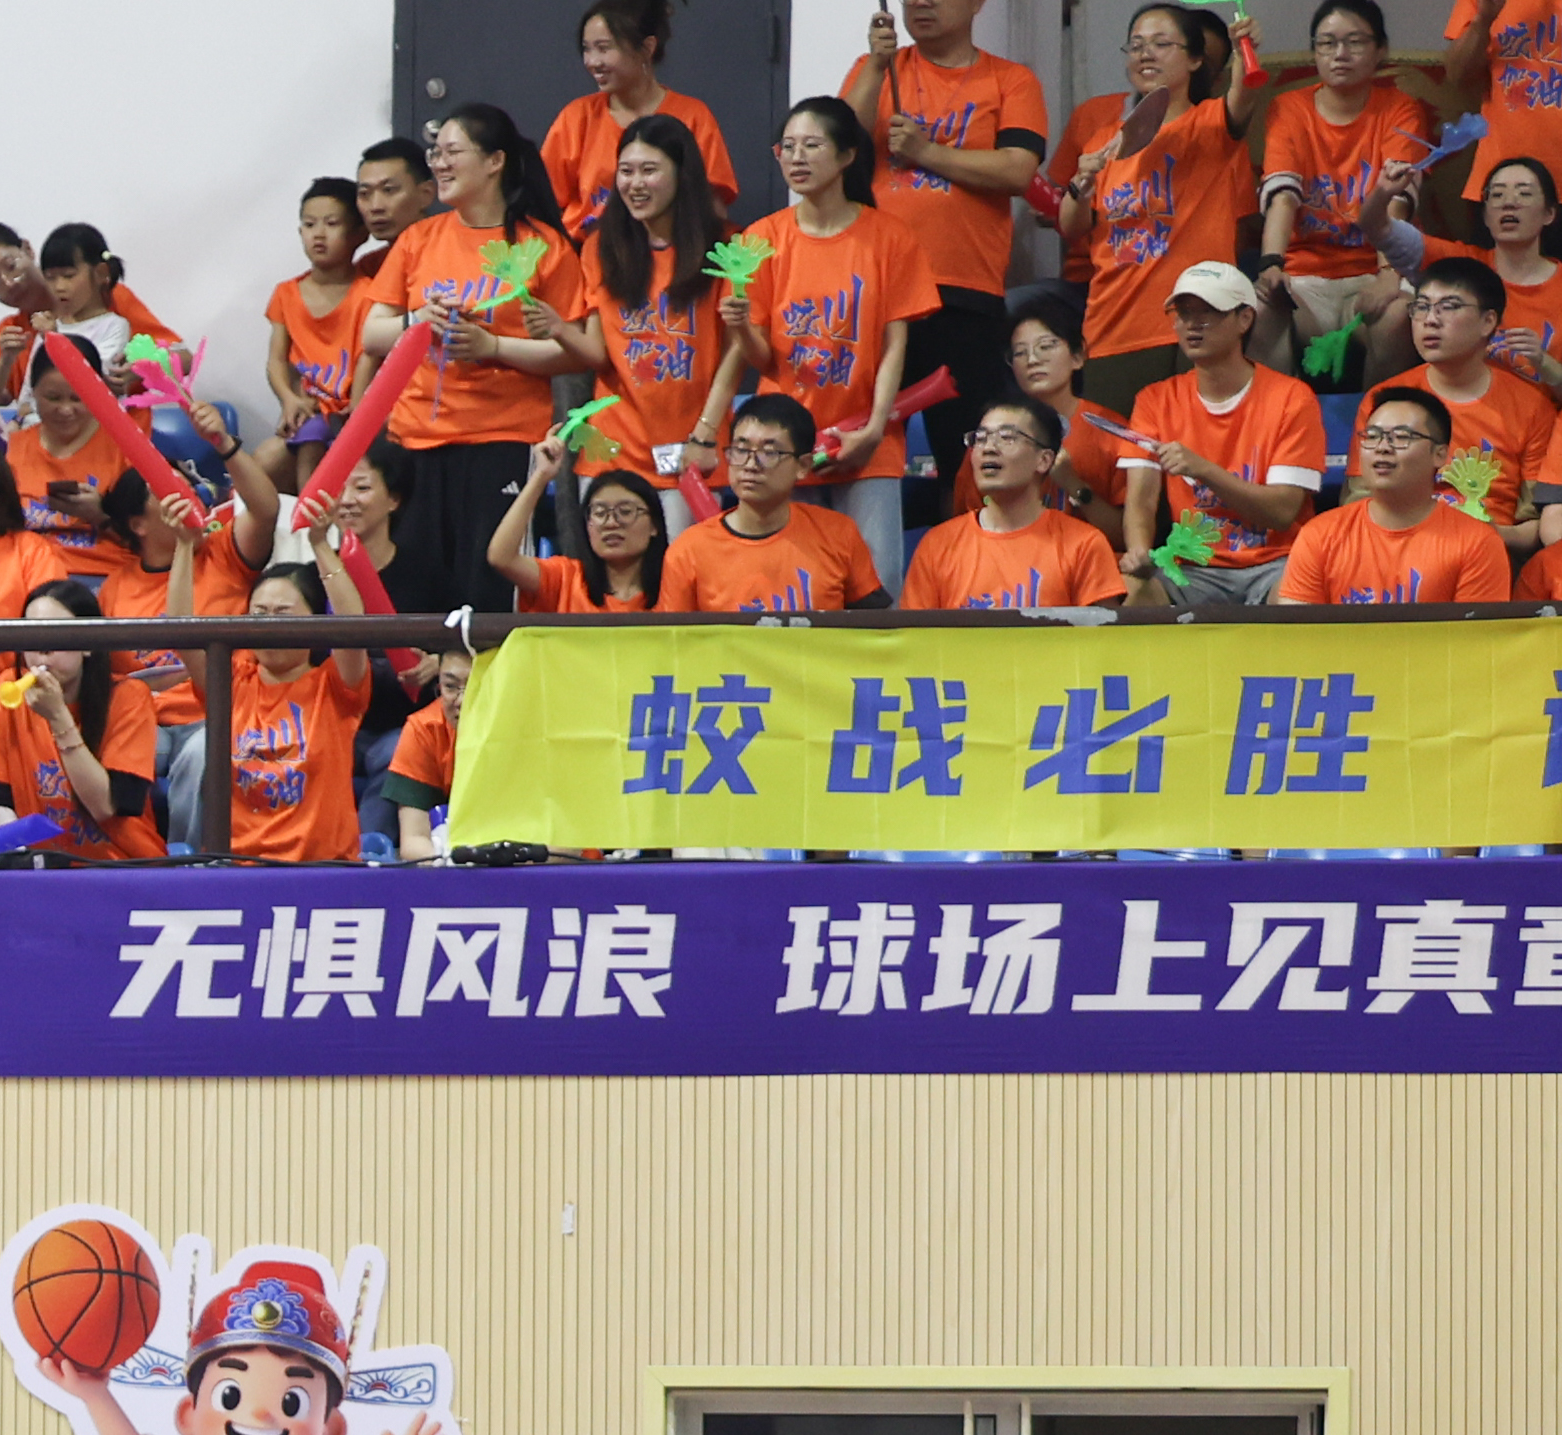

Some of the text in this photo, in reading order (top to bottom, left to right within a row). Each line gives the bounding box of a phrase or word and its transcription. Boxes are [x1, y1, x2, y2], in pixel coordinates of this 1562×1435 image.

[1103, 153, 1175, 221] 蛟川
[1107, 219, 1172, 265] 加油
[619, 292, 697, 337] 蛟川
[782, 272, 865, 343] 蛟川
[622, 337, 697, 384] 加油
[787, 340, 857, 389] 加油
[232, 699, 308, 763] 蛟川
[621, 672, 1375, 796] 蛟战必胜
[236, 765, 308, 809] 加油
[108, 904, 677, 1019] 无惧风浪
